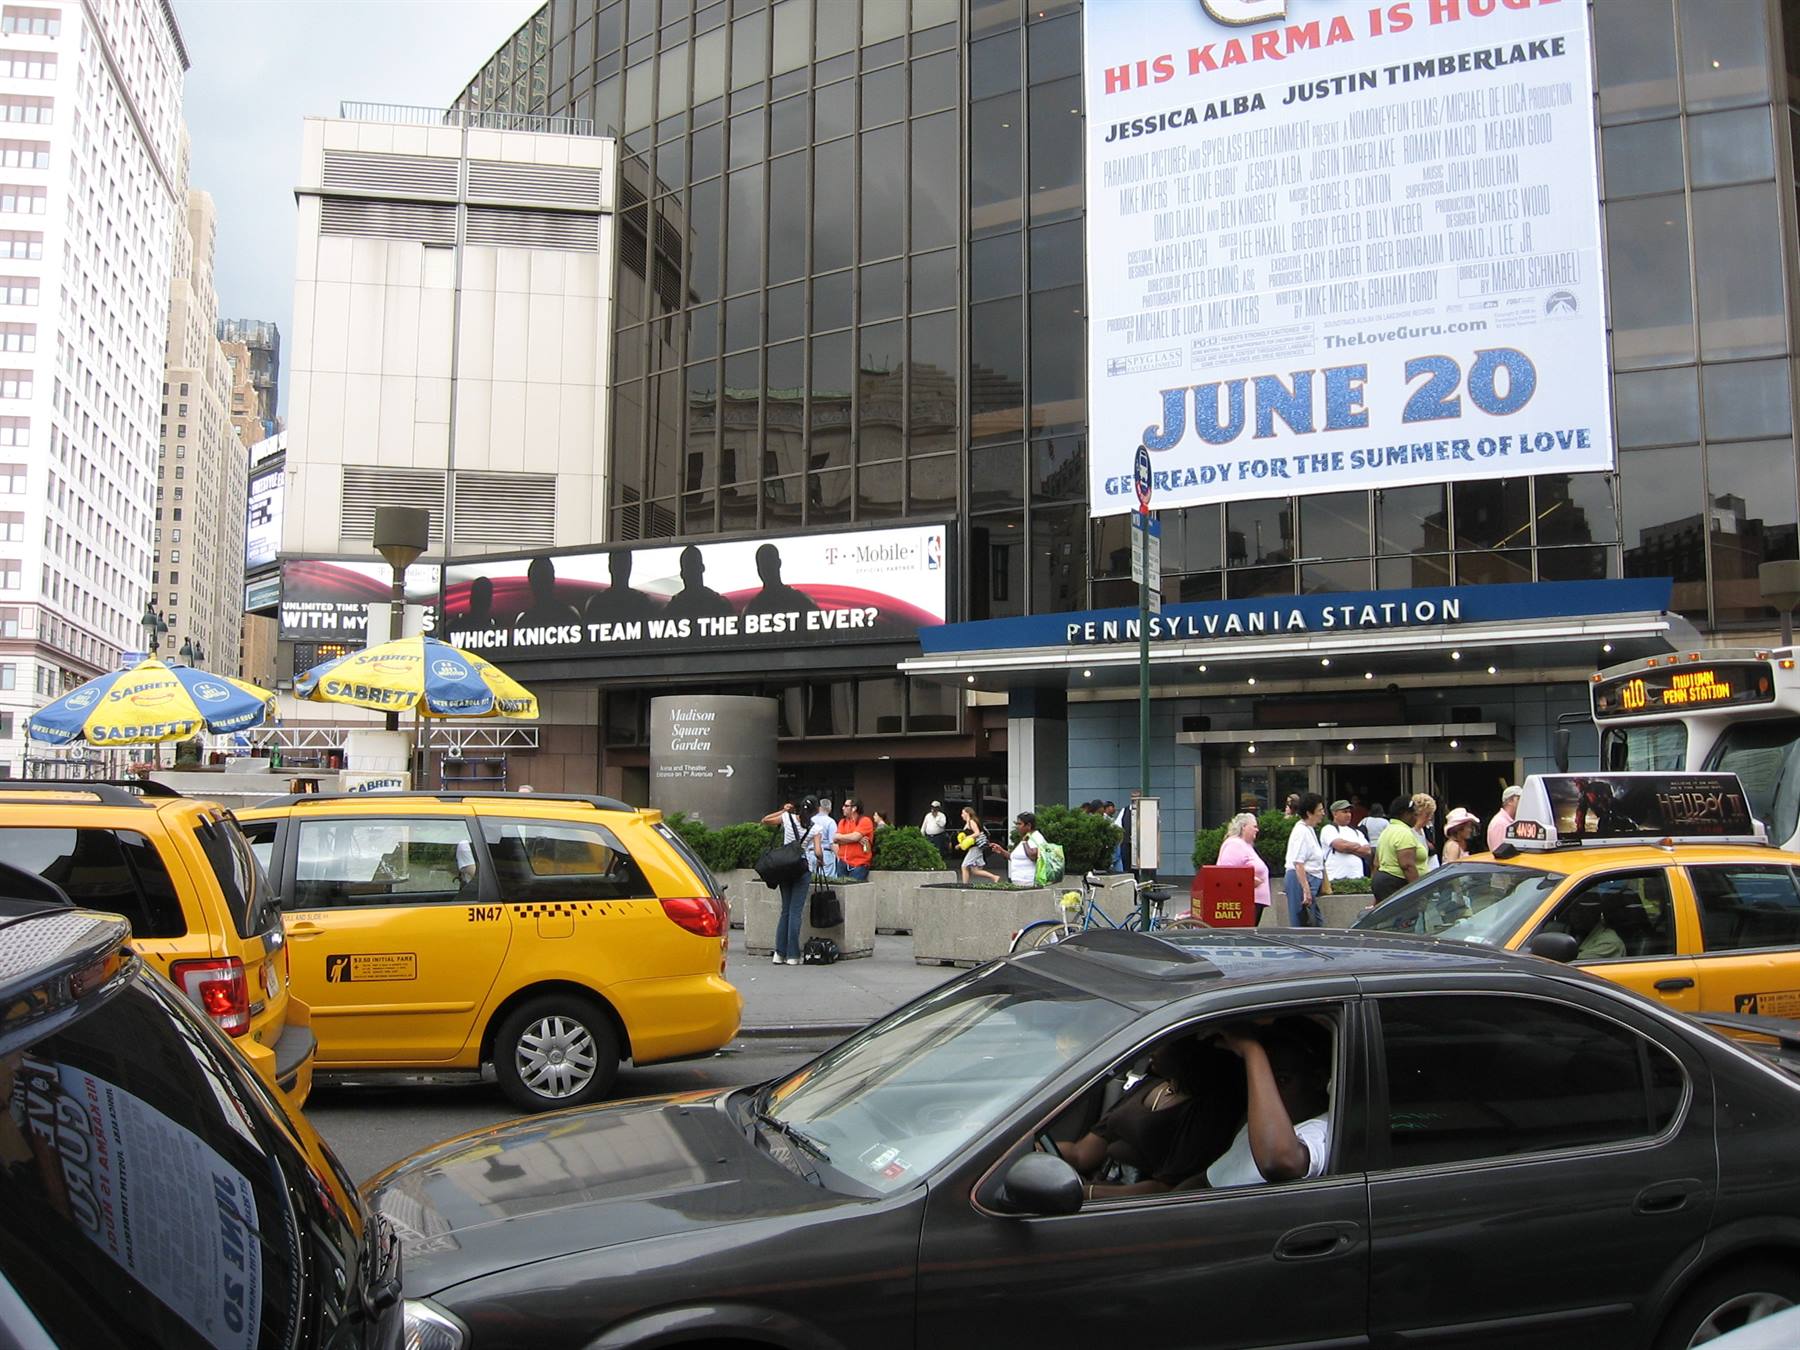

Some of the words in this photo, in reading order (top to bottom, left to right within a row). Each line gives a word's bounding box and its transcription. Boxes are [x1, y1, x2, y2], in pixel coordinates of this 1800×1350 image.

[1104, 54, 1175, 95] HIS
[1187, 16, 1354, 76] KARMA
[1368, 2, 1414, 38] IS
[1104, 107, 1198, 143] JESSICA
[1203, 93, 1266, 122] ALBA
[1282, 70, 1377, 105] JUSTIN
[1383, 36, 1566, 86] TIMBERLAKE
[1104, 153, 1149, 188] PARAMOUNT
[1151, 145, 1187, 180] PICTURES
[1201, 133, 1243, 168] SPYGLASS
[1244, 120, 1310, 160] ENTERTAINMENT
[1312, 120, 1339, 146] PRESENT
[1349, 101, 1410, 140] NOMONEYFUN
[1488, 86, 1501, 117] DE
[1502, 82, 1527, 115] LUCA
[1528, 82, 1573, 111] PRODUCTION
[1119, 186, 1140, 217] MIKE
[1141, 180, 1168, 211] MYERS
[1192, 170, 1213, 202] LOVE
[1244, 160, 1278, 192] JESSICA
[1280, 155, 1303, 186] ALBA
[1310, 147, 1340, 180] JUSTIN
[1341, 138, 1396, 175] TIMBERLAKE
[1403, 130, 1442, 165] ROMANY
[1444, 124, 1477, 158] MALCO
[1484, 116, 1526, 152] MEAGAN
[1526, 112, 1552, 146] GOOD
[1404, 180, 1444, 200] SUPERVISOR
[1446, 160, 1471, 193] JOHN
[1472, 153, 1519, 189] HOULIHAN
[1422, 164, 1444, 181] MUSIC
[1288, 186, 1309, 204] MUSIC
[1299, 201, 1310, 217] BY
[1310, 180, 1341, 215] GEORGE
[1354, 172, 1391, 207] CLINTON
[1434, 195, 1476, 214] PRODUCTION
[1446, 210, 1477, 229] DESIGNER
[1477, 188, 1519, 225] CHARLES
[1520, 184, 1551, 218] WOOD
[1153, 211, 1174, 242] OMID
[1220, 198, 1237, 230] BEN
[1238, 192, 1278, 226] KINGSLEY
[1229, 246, 1238, 262] BY
[1238, 230, 1253, 260] LEE
[1254, 223, 1287, 257] HAXALL
[1291, 216, 1329, 252] GREGORY
[1331, 211, 1362, 246] PERLER
[1366, 208, 1390, 240] BILLY
[1391, 202, 1424, 237] WEBER
[1154, 244, 1181, 275] KAREN
[1182, 237, 1208, 270] PATCH
[1268, 270, 1303, 288] PRODUCERS
[1303, 250, 1326, 283] GARY
[1328, 245, 1362, 280] BARBER
[1366, 241, 1394, 273] ROGER
[1396, 232, 1444, 269] BIRNBAUM
[1448, 227, 1485, 262] DONALD
[1270, 254, 1302, 273] EXECUTIVE
[1182, 270, 1206, 302] PETER
[1207, 264, 1239, 298] DEMING
[1459, 263, 1490, 281] DIRECTED
[1480, 278, 1490, 294] BY
[1491, 258, 1526, 292] MARCO
[1527, 251, 1579, 288] SCHNABEL
[1275, 289, 1303, 306] WRITTEN
[1294, 303, 1303, 319] BY
[1304, 285, 1327, 317] MIKE
[1328, 280, 1361, 314] MYERS
[1368, 272, 1408, 308] GRAHAM
[1409, 270, 1438, 302] GORDY
[1107, 315, 1135, 333] PRODUCED
[1126, 330, 1135, 345] BY
[1135, 311, 1169, 342] MICHAEL
[1171, 307, 1182, 337] DE
[1183, 303, 1204, 334] LUCA
[1208, 299, 1229, 331] MIKE
[1231, 295, 1260, 328] MYERS
[1323, 318, 1488, 350] TheLoveGuru.com
[1127, 348, 1182, 366] SPYGLASS
[1142, 363, 1369, 452] JUNE
[1401, 347, 1537, 424] 20
[1153, 462, 1233, 492] READY
[1238, 457, 1292, 481] FOR
[1293, 451, 1345, 475] THE
[1350, 438, 1475, 471] SUMMER
[1477, 435, 1513, 458] OF
[1519, 427, 1591, 454] LOVE
[282, 601, 335, 611] UNLIMITED
[336, 602, 359, 612] TIME
[361, 604, 369, 612] T
[282, 611, 337, 629] WITH
[450, 629, 508, 649] WHICH
[513, 625, 582, 646] KNICKS
[587, 621, 643, 642] TEAM
[647, 618, 691, 640] WAS
[697, 615, 739, 637] THE
[745, 611, 800, 634] BEST
[806, 607, 879, 631] EVER?
[1066, 608, 1307, 642] PENNSYLVANIA
[1322, 598, 1461, 628] STATION
[355, 653, 422, 665] SABRETT
[110, 680, 178, 702] SABRETT
[325, 681, 419, 706] SABRETT
[1622, 678, 1646, 709] M10
[1663, 688, 1688, 705] PENN
[1690, 682, 1730, 702] STATION
[669, 708, 716, 721] Madison
[92, 719, 195, 741] SABRETT
[671, 723, 711, 738] Square
[671, 737, 712, 751] Garden
[1656, 793, 1724, 818] HELLBOY
[1515, 822, 1537, 839] 4N90
[468, 907, 502, 922] 3N47
[1214, 910, 1243, 919] DAILY
[1216, 902, 1241, 911] FREE
